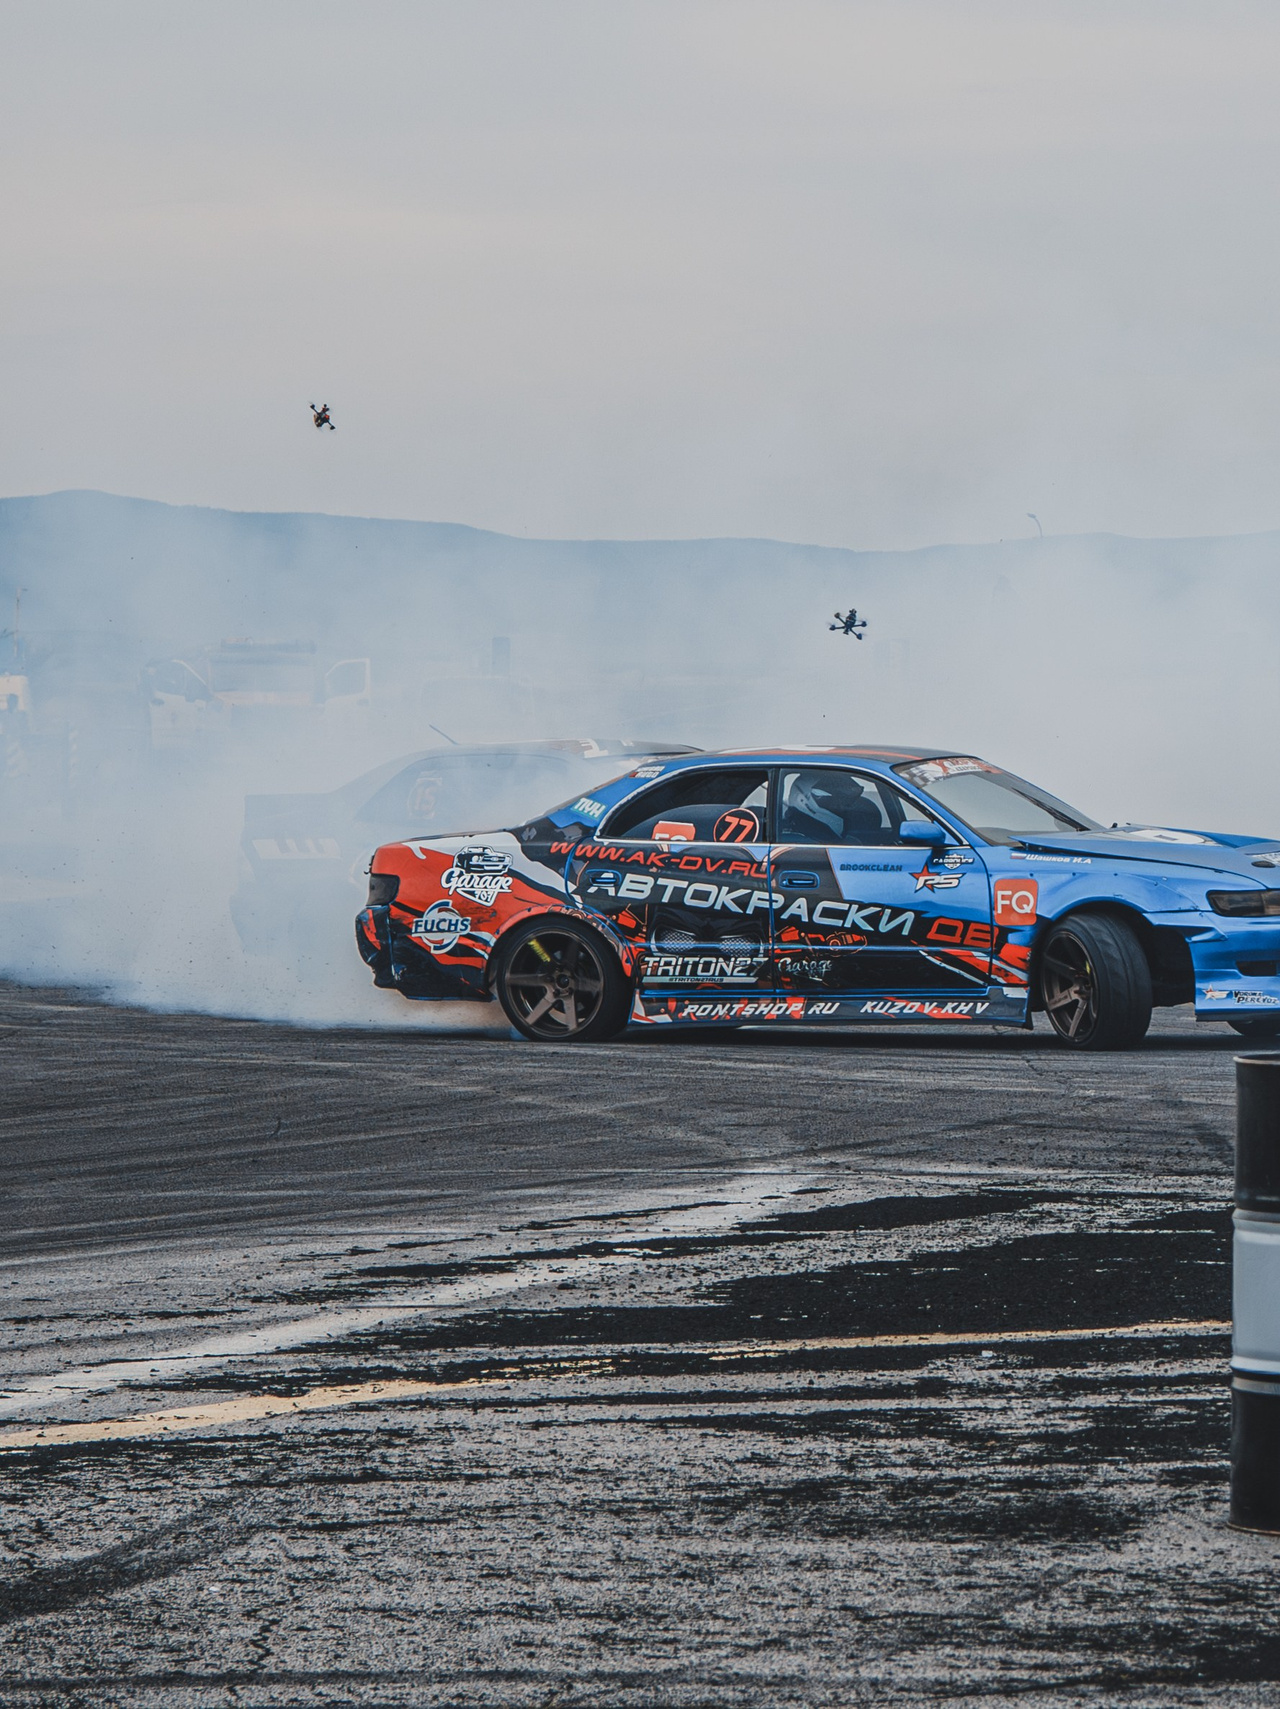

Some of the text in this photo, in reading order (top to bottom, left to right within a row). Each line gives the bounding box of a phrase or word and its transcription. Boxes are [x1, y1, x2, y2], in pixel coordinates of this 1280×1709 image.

[719, 815, 755, 842] 77
[550, 841, 776, 879] WWW.AK-DV.RU
[839, 863, 903, 872] BROOKCLEAN
[440, 867, 514, 896] Garage
[997, 890, 1034, 915] FQ
[414, 918, 470, 934] FUCHS
[643, 956, 769, 977] TRITON27
[682, 1002, 841, 1017] PONTSHOP.RU
